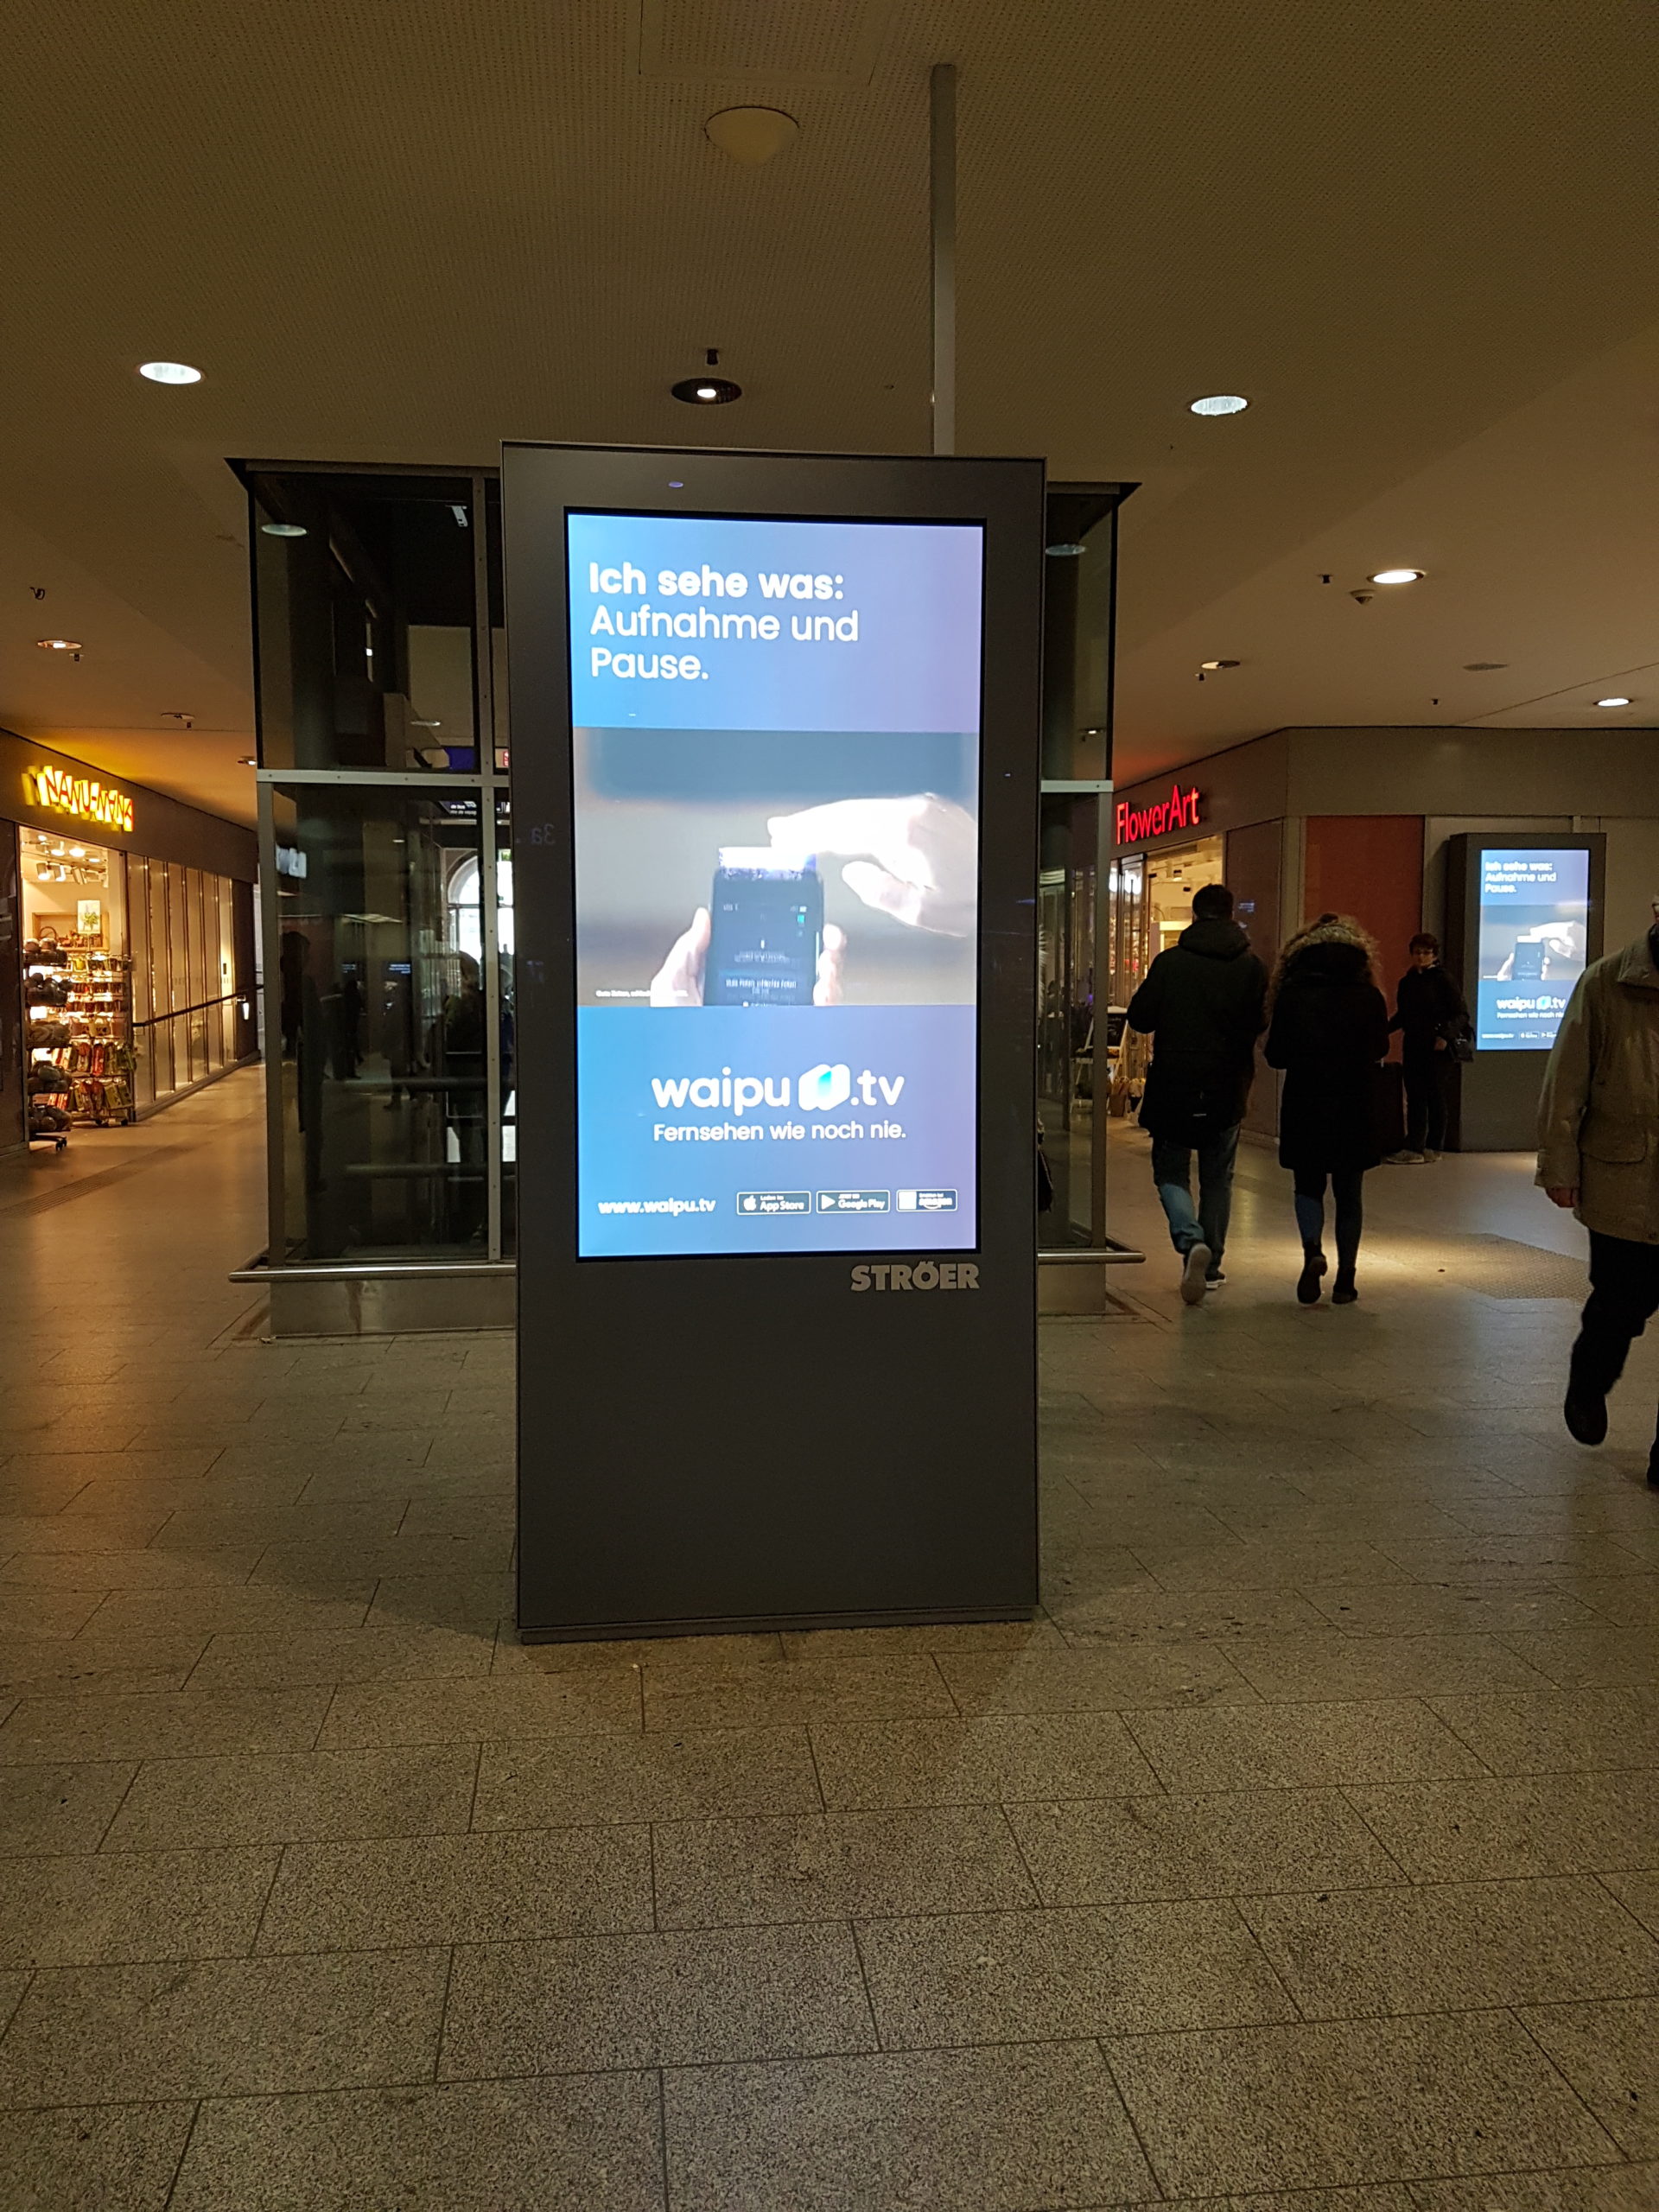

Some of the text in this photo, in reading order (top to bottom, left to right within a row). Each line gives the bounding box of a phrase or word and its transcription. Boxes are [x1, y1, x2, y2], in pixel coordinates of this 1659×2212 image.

[589, 562, 844, 600] Ich sehe was:
[589, 604, 859, 642] Aufnahme und
[591, 647, 709, 680] Pause.
[1116, 785, 1199, 845] FlowerArt
[1537, 872, 1556, 882] und
[1497, 996, 1535, 1011] waipu
[651, 1066, 905, 1116] waipu .tv
[653, 1119, 906, 1141] Fernsehen wie noch nie.
[597, 1197, 716, 1217] www.waipu.tv
[760, 1200, 805, 1212] App Store
[838, 1198, 886, 1211] Google Play
[850, 1261, 980, 1292] STRÖER
